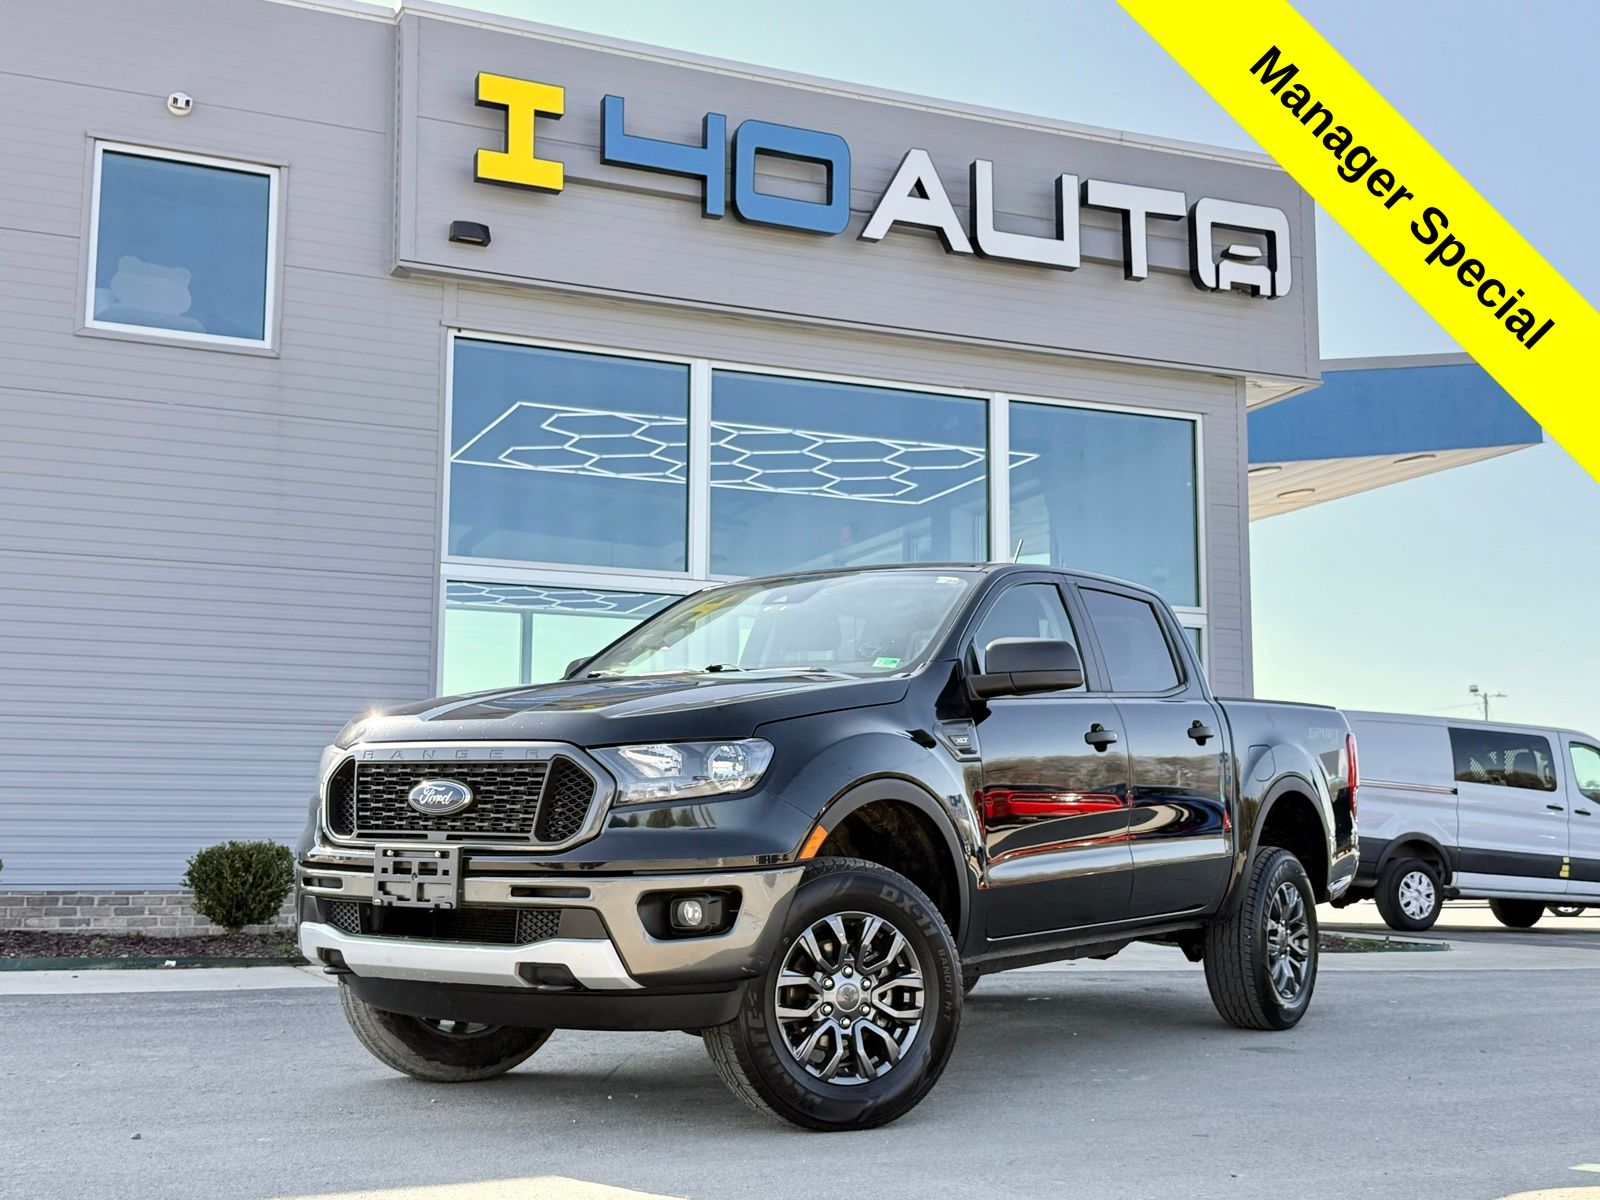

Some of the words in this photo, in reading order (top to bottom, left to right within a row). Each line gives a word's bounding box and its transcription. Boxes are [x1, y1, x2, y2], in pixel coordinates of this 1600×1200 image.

[859, 148, 1292, 300] AUTO
[955, 736, 969, 744] XLT
[1306, 727, 1342, 739] SPORT
[362, 749, 539, 760] RANGER
[418, 785, 454, 805] Ford
[879, 884, 938, 937] DX-11
[937, 949, 952, 994] BANDIT
